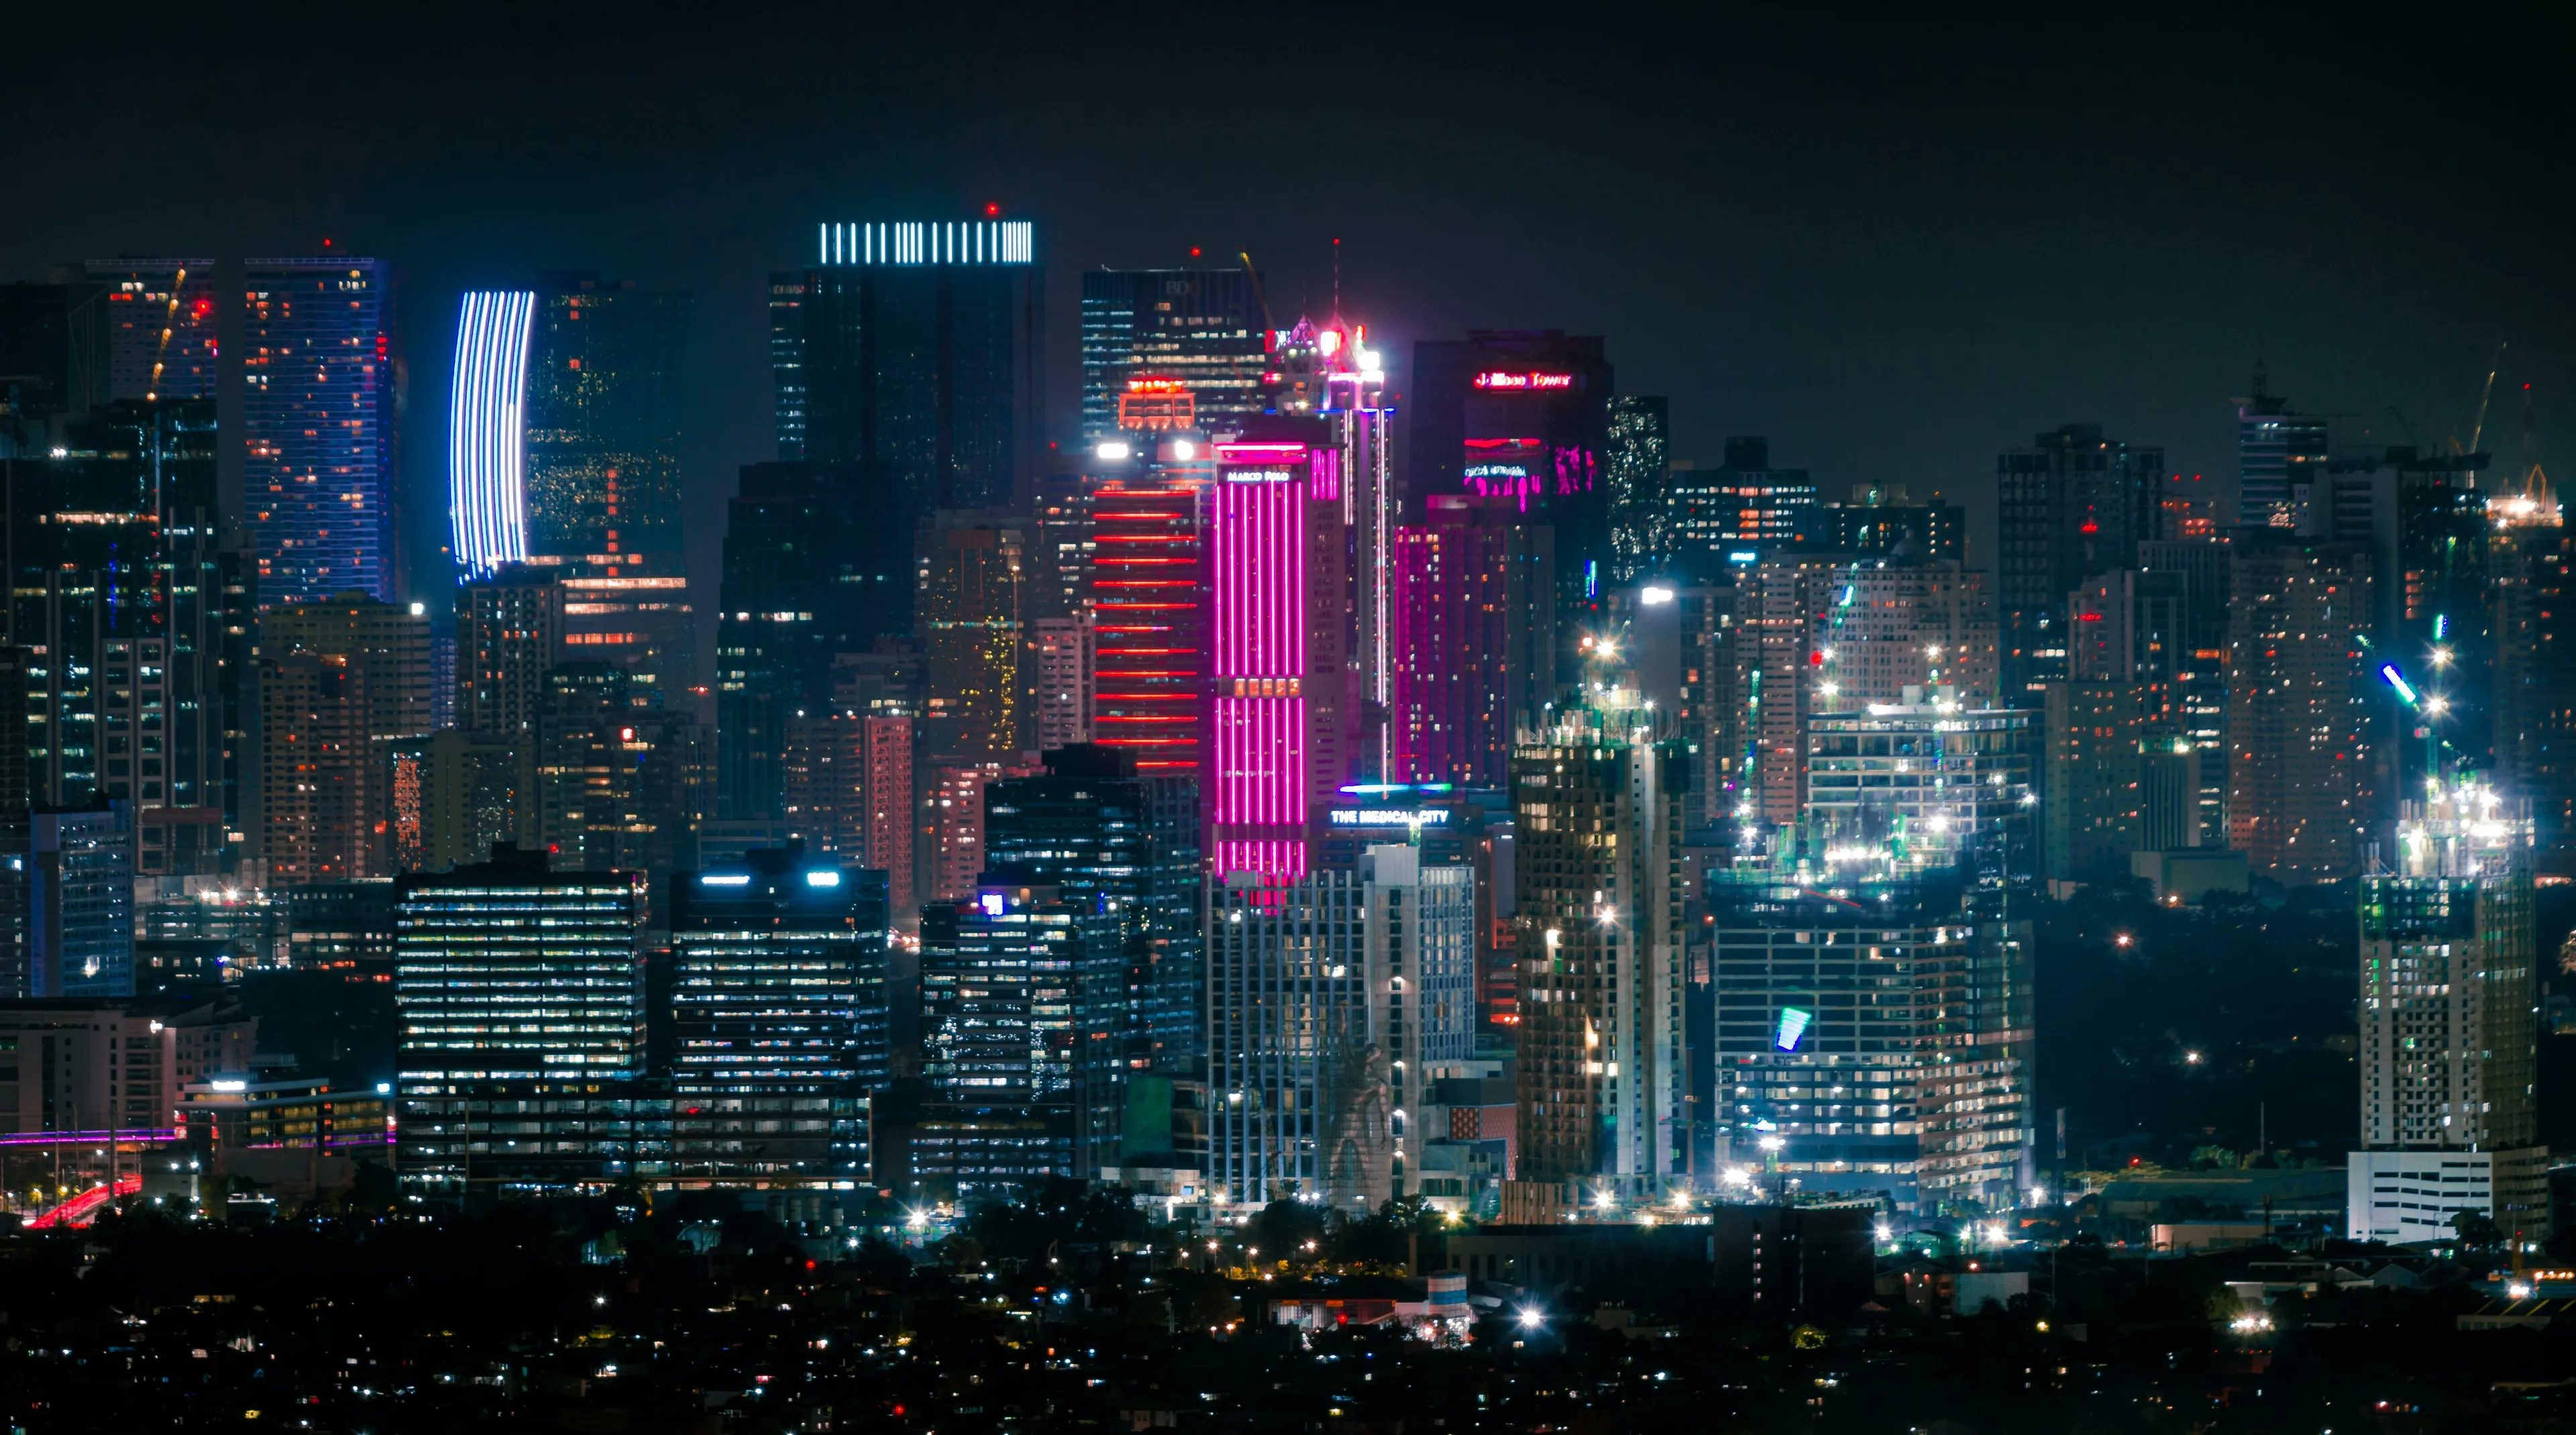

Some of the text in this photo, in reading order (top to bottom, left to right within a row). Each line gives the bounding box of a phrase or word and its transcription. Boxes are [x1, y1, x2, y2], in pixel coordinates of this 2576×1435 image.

[1166, 280, 1202, 295] BDO
[1529, 372, 1571, 387] Tower
[1227, 471, 1289, 482] MARCO POLO
[1331, 810, 1358, 824] THE
[1419, 810, 1449, 824] CITY
